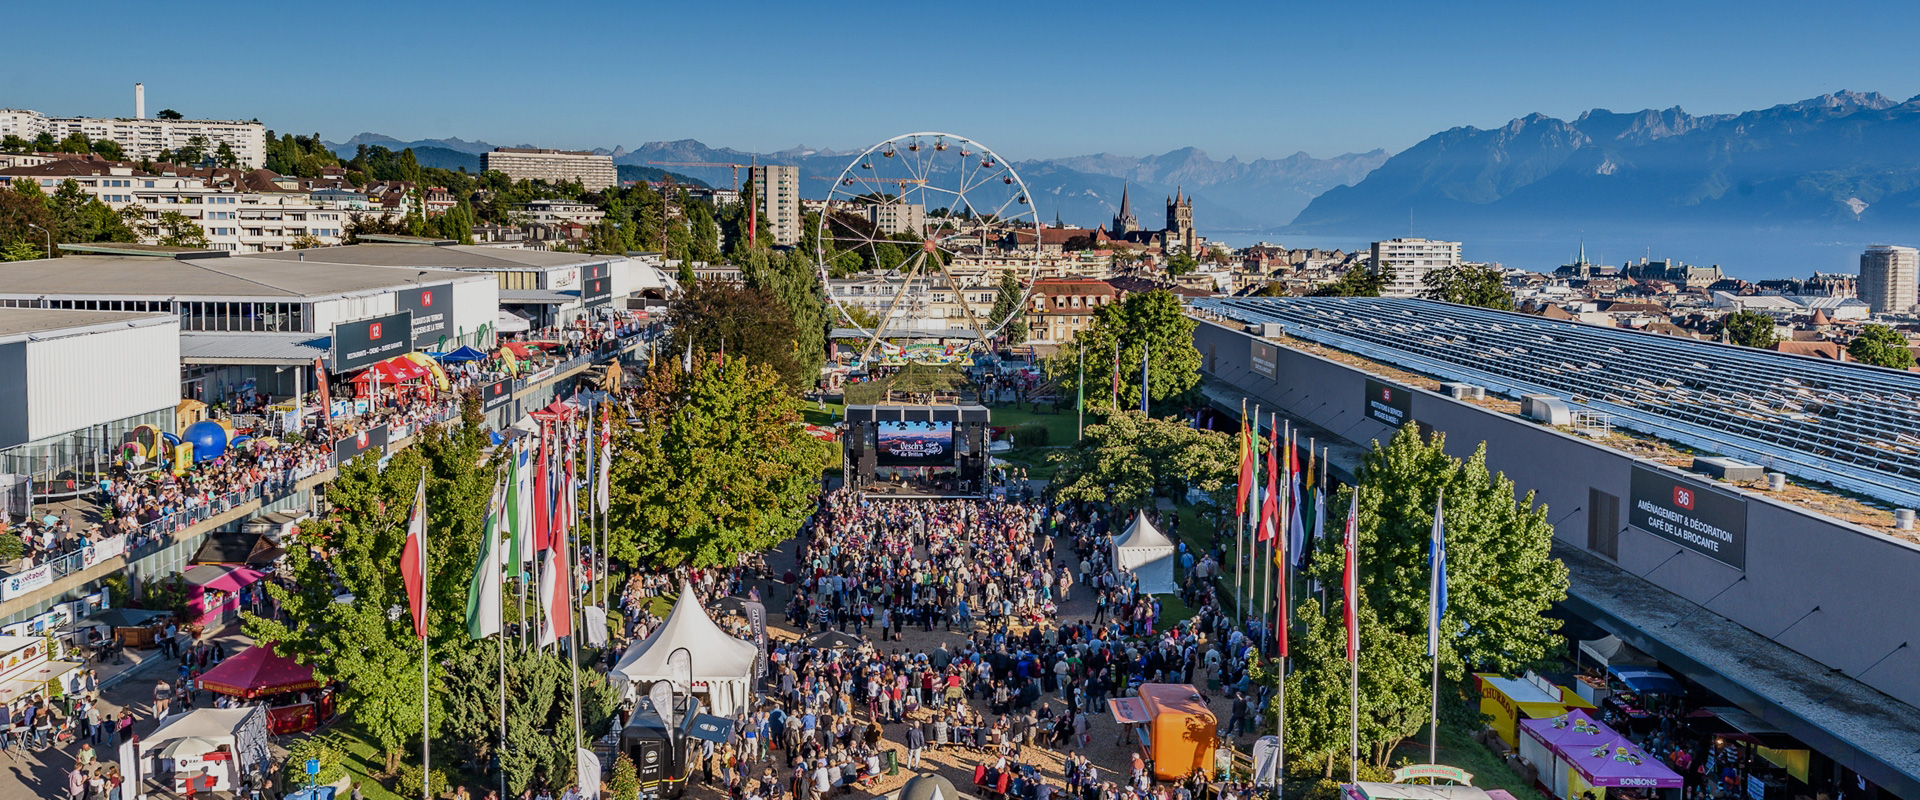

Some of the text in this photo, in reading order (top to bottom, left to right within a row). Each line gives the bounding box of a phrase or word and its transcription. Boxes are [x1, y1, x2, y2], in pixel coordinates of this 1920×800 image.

[424, 294, 430, 304] 14
[373, 326, 379, 337] 12
[900, 441, 924, 450] Oesch's
[1678, 491, 1689, 505] 36
[1638, 500, 1733, 543] AMÉNAGEMENT & DÉCORATION
[1648, 516, 1719, 552] CAFÉ DE LA BROCANTE
[1481, 687, 1515, 720] CHURROS
[1409, 768, 1456, 777] Brezelkutsche
[1620, 778, 1657, 786] BONBONS
